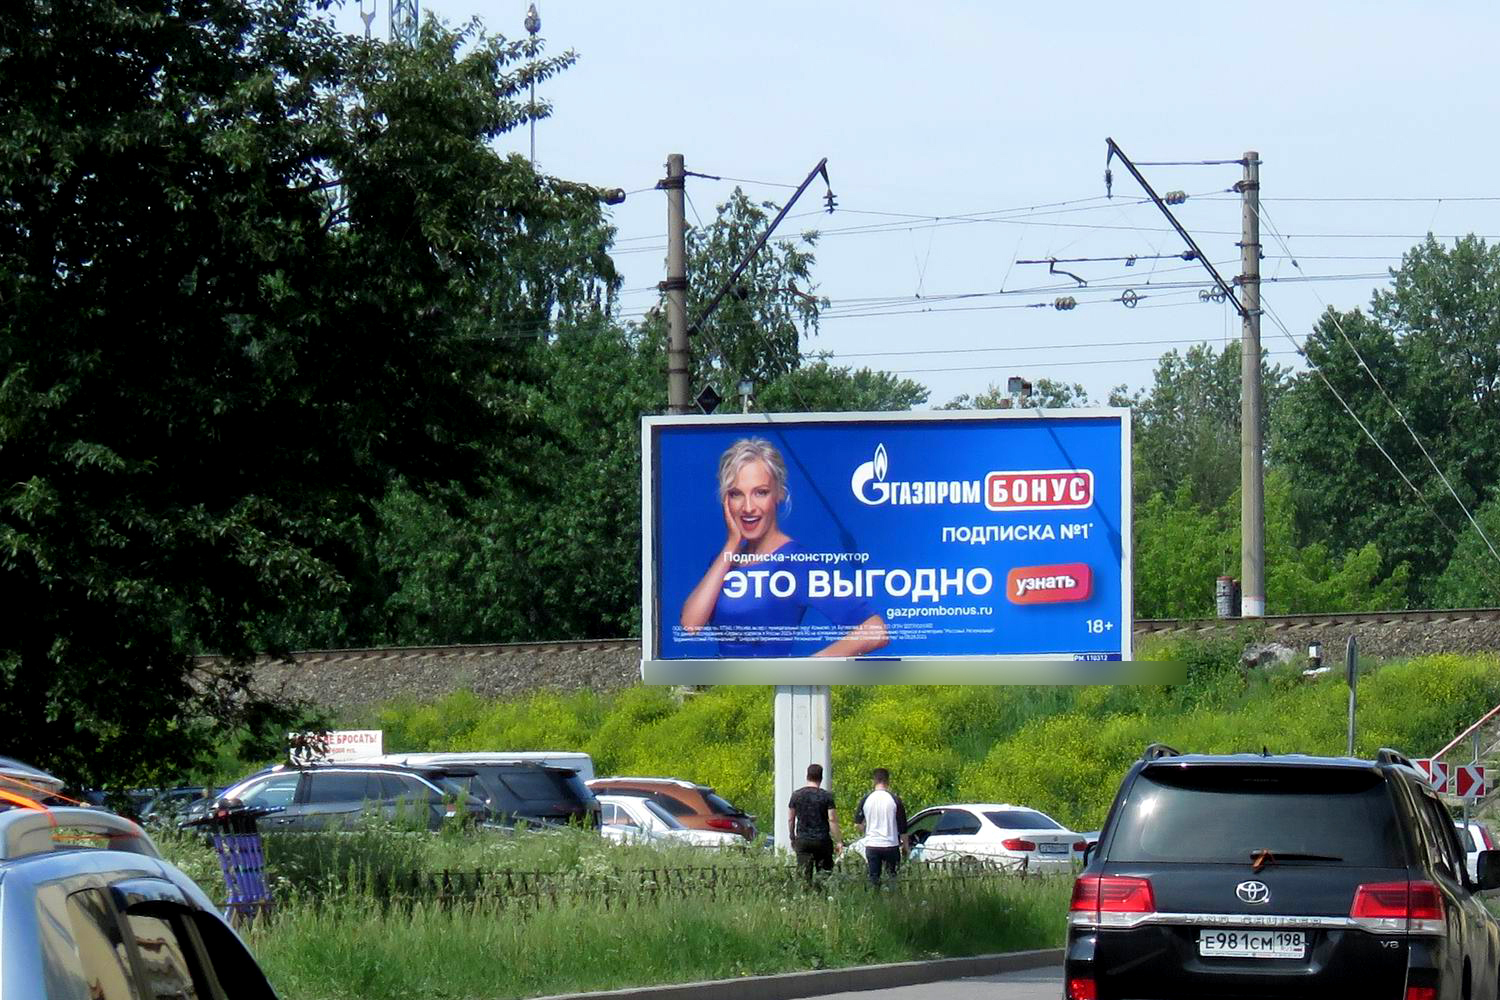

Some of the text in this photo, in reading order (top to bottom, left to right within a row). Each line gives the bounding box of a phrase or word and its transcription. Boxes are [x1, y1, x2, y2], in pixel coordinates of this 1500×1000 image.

[890, 477, 1088, 505] ГАЗПРОМ БОНУС
[942, 525, 1056, 545] ПОДПИСКА
[723, 551, 870, 565] Подписка-конструктор
[723, 567, 993, 603] ЭТО ВЫГОДНО
[1015, 575, 1077, 596] узнать
[886, 605, 993, 620] gazprombonus.ru
[1086, 619, 1114, 634] 18+
[1184, 914, 1323, 927] LAND CRUISER
[1380, 939, 1400, 949] V8
